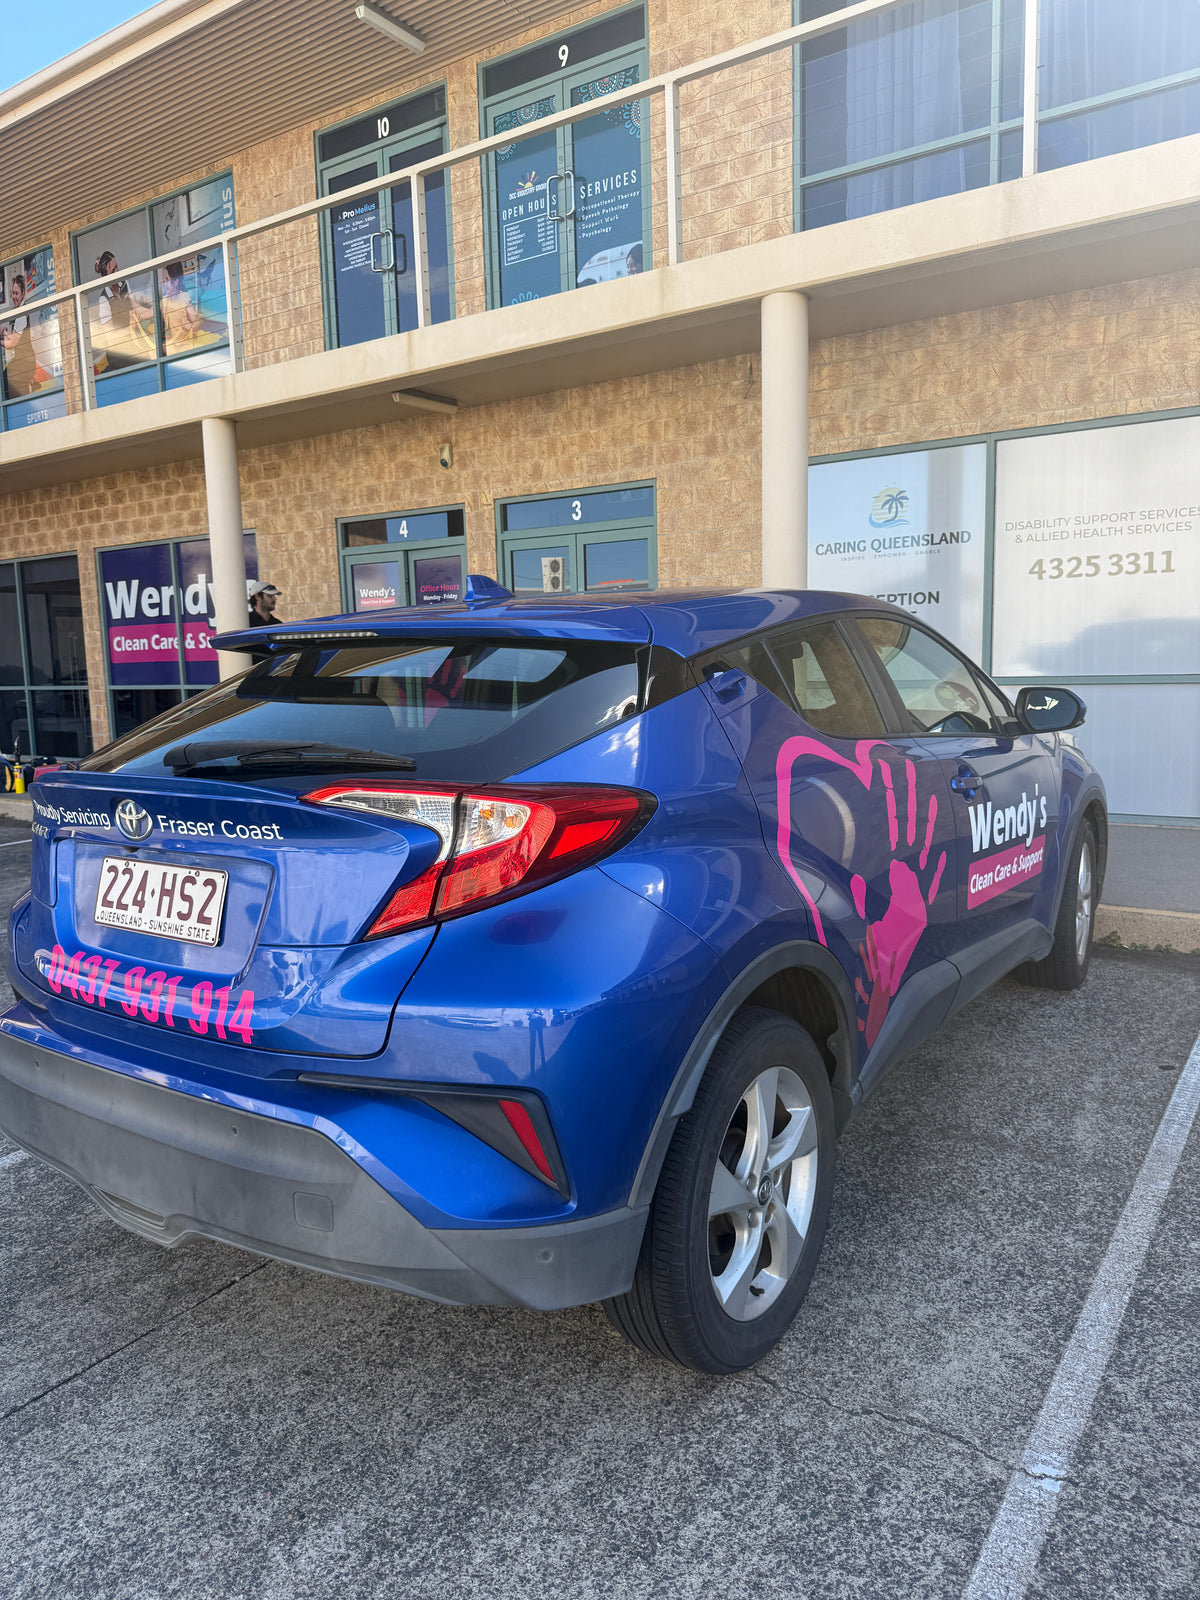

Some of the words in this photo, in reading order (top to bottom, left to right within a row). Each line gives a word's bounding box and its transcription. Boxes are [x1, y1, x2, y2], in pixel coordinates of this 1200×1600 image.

[558, 44, 569, 67] 9
[377, 116, 390, 138] 10
[580, 169, 637, 200] SERVICES
[342, 203, 376, 220] ProMelius
[502, 204, 524, 221] OPEN
[528, 194, 557, 213] HOUS
[581, 196, 616, 212] Occupational
[617, 190, 640, 202] Therapy
[581, 210, 601, 222] Speech
[571, 500, 582, 521] 3
[1005, 517, 1071, 532] DISABILITY
[1074, 511, 1137, 526] SUPPORT
[399, 520, 409, 538] 4
[1014, 534, 1023, 544] &
[1025, 529, 1070, 543] ALLIED
[1073, 525, 1124, 539] HEALTH
[1127, 521, 1193, 536] SERVICES
[815, 539, 867, 556] CARING
[870, 530, 972, 551] QUEENSLAND
[873, 551, 907, 559] EMPOWER
[1028, 554, 1101, 580] 4325
[1107, 550, 1176, 576] 3311
[359, 586, 396, 599] Wendy's
[420, 585, 439, 593] Office
[440, 583, 460, 592] Hours
[423, 594, 440, 602] Monday
[443, 593, 458, 601] Friday
[113, 636, 149, 652] Clean
[151, 634, 179, 651] Care
[185, 633, 195, 649] &
[60, 807, 111, 830] Servicing
[157, 815, 214, 836] Fraser
[221, 820, 284, 840] Coast
[968, 783, 1047, 853] Wendy's
[970, 871, 993, 894] Clean
[994, 861, 1011, 882] Care
[1011, 857, 1018, 875] &
[1018, 847, 1044, 873] Support
[100, 910, 142, 927] QUEENSLAND
[149, 919, 184, 936] SUNSHINE
[187, 926, 210, 940] STATE
[48, 944, 121, 1008] 0437
[121, 966, 183, 1027] 931
[187, 981, 255, 1044] 914
